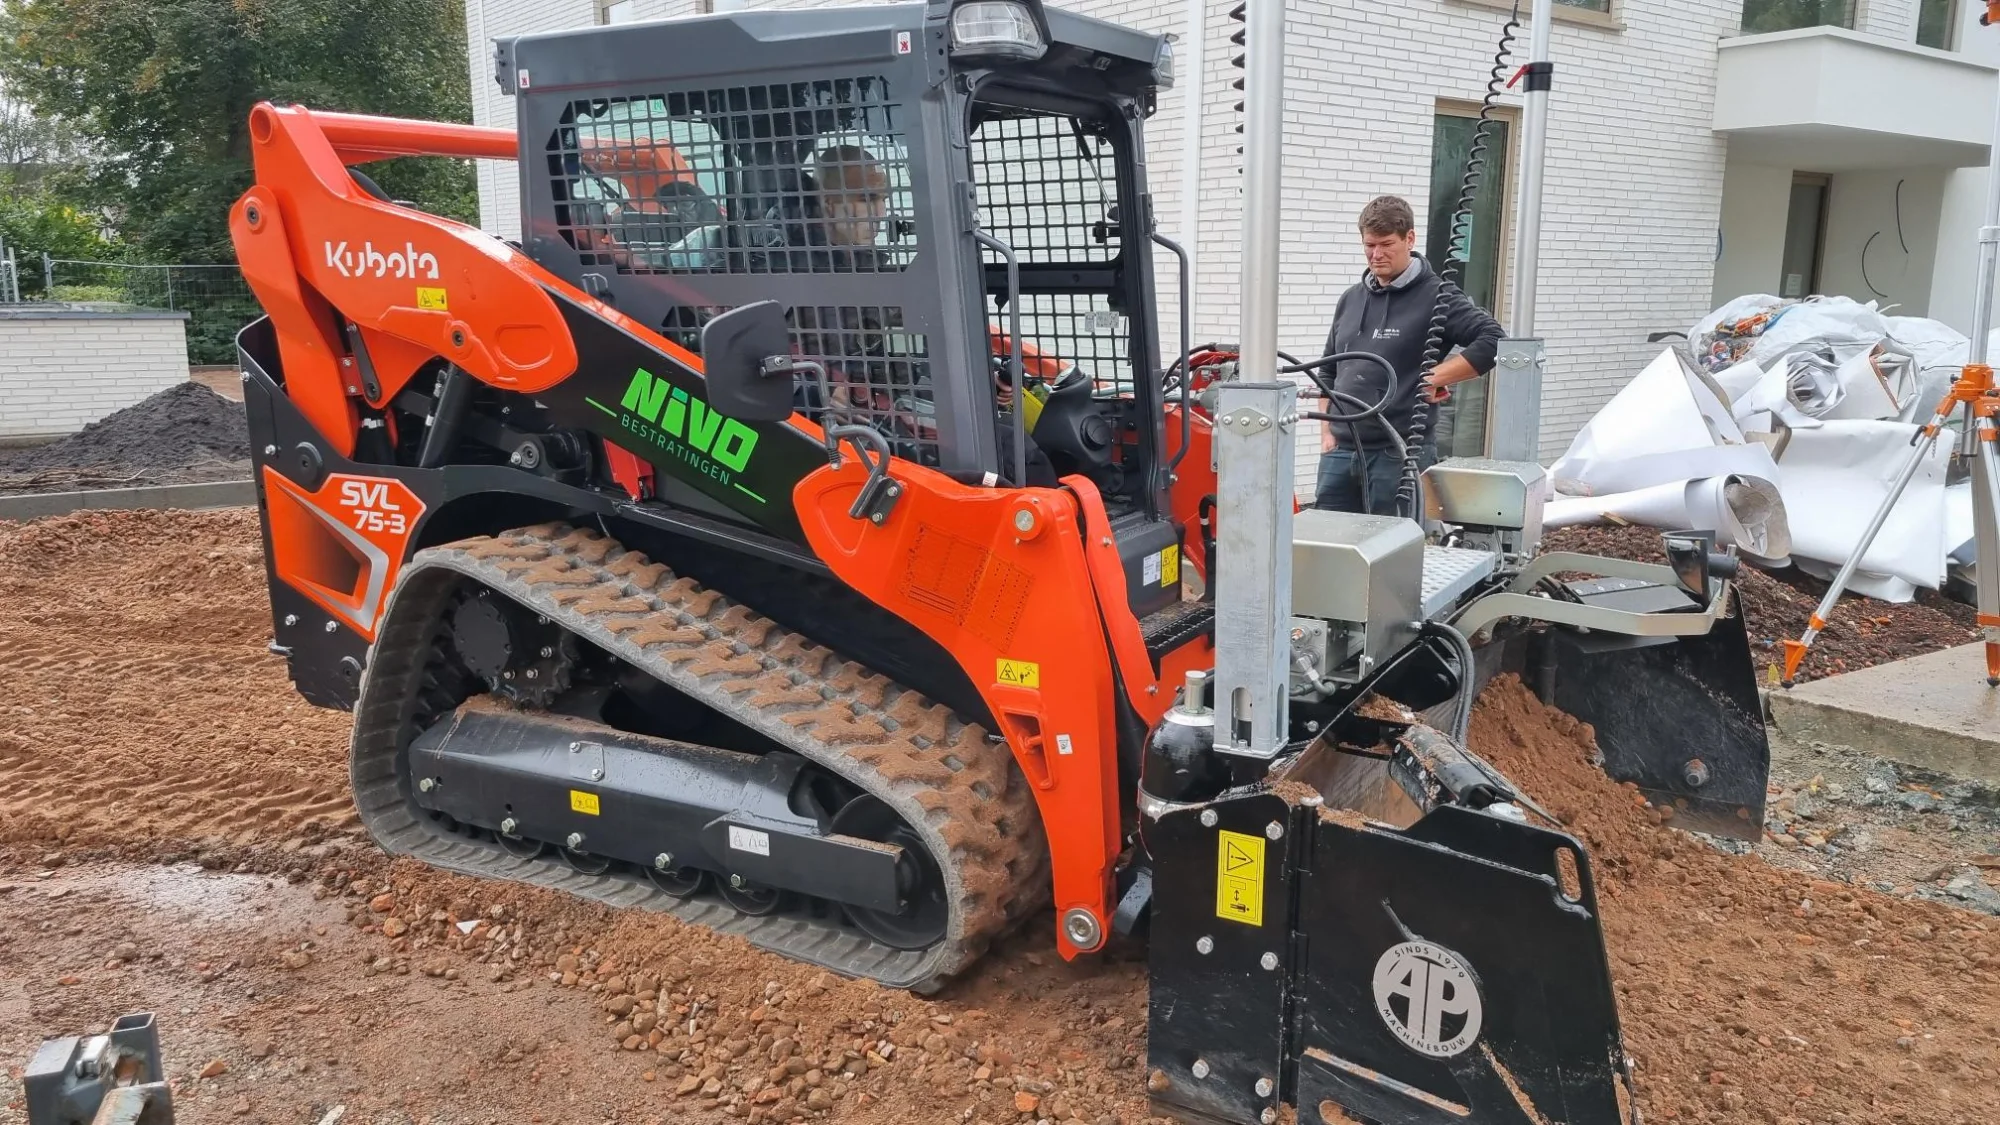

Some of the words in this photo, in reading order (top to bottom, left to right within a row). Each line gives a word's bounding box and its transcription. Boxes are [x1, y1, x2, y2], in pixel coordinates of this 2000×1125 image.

[324, 241, 440, 279] Kubota
[621, 413, 731, 486] BESTRATINGEN
[339, 480, 400, 511] SVL
[353, 509, 406, 535] 75-3
[1394, 945, 1429, 958] SINDS
[1383, 1008, 1466, 1053] MACHINEBOUW
